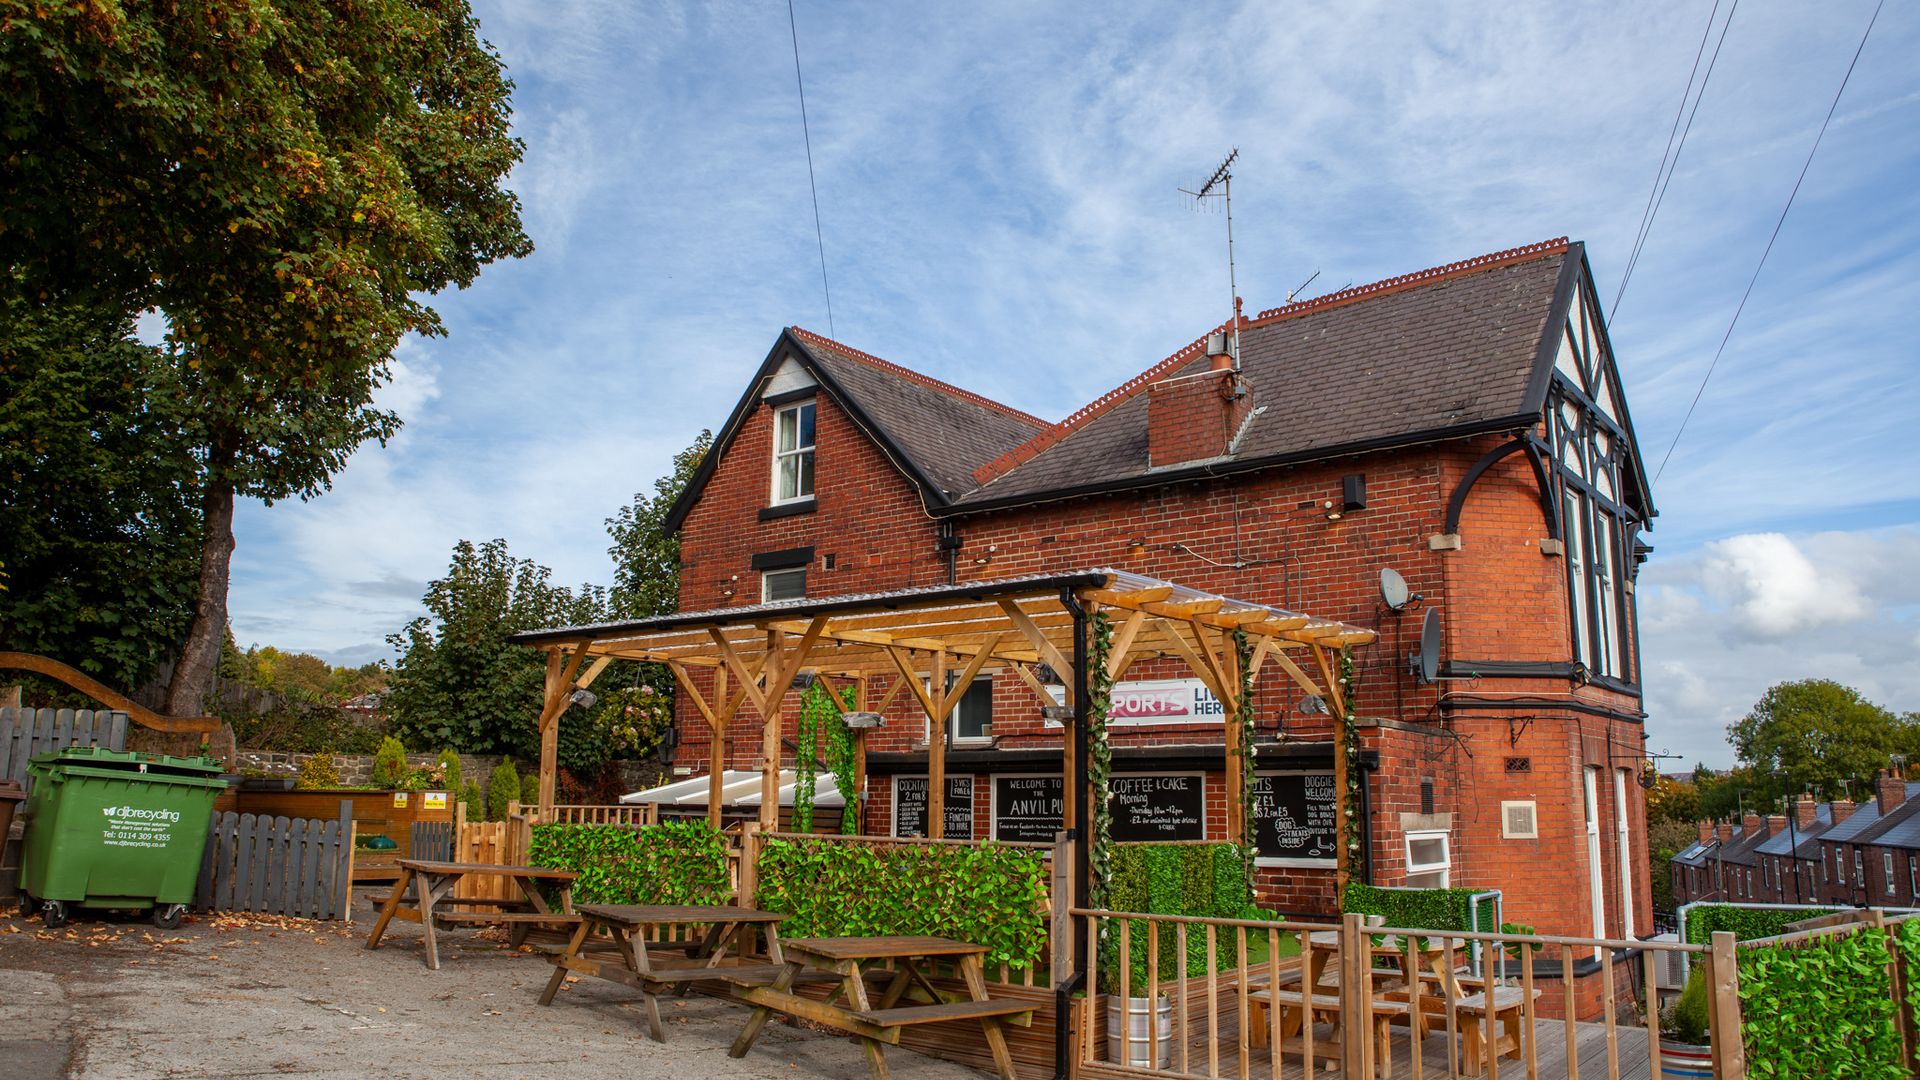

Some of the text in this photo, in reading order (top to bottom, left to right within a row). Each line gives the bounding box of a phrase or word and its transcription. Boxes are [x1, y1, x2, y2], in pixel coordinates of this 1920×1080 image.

[1111, 687, 1217, 713] PORTS LIV
[899, 780, 929, 791] COCKTAIL
[1010, 779, 1062, 789] WELCOME TO
[1113, 779, 1153, 794] COFFEE
[1162, 777, 1188, 791] CAKE
[905, 791, 911, 801] 2
[1120, 793, 1148, 808] Morning
[1010, 798, 1064, 815] ANVIL PU
[116, 806, 180, 823] djbrecycling
[1278, 821, 1292, 830] DOG
[138, 832, 152, 840] 309
[103, 840, 166, 848] www.djbrecycling.co.uk
